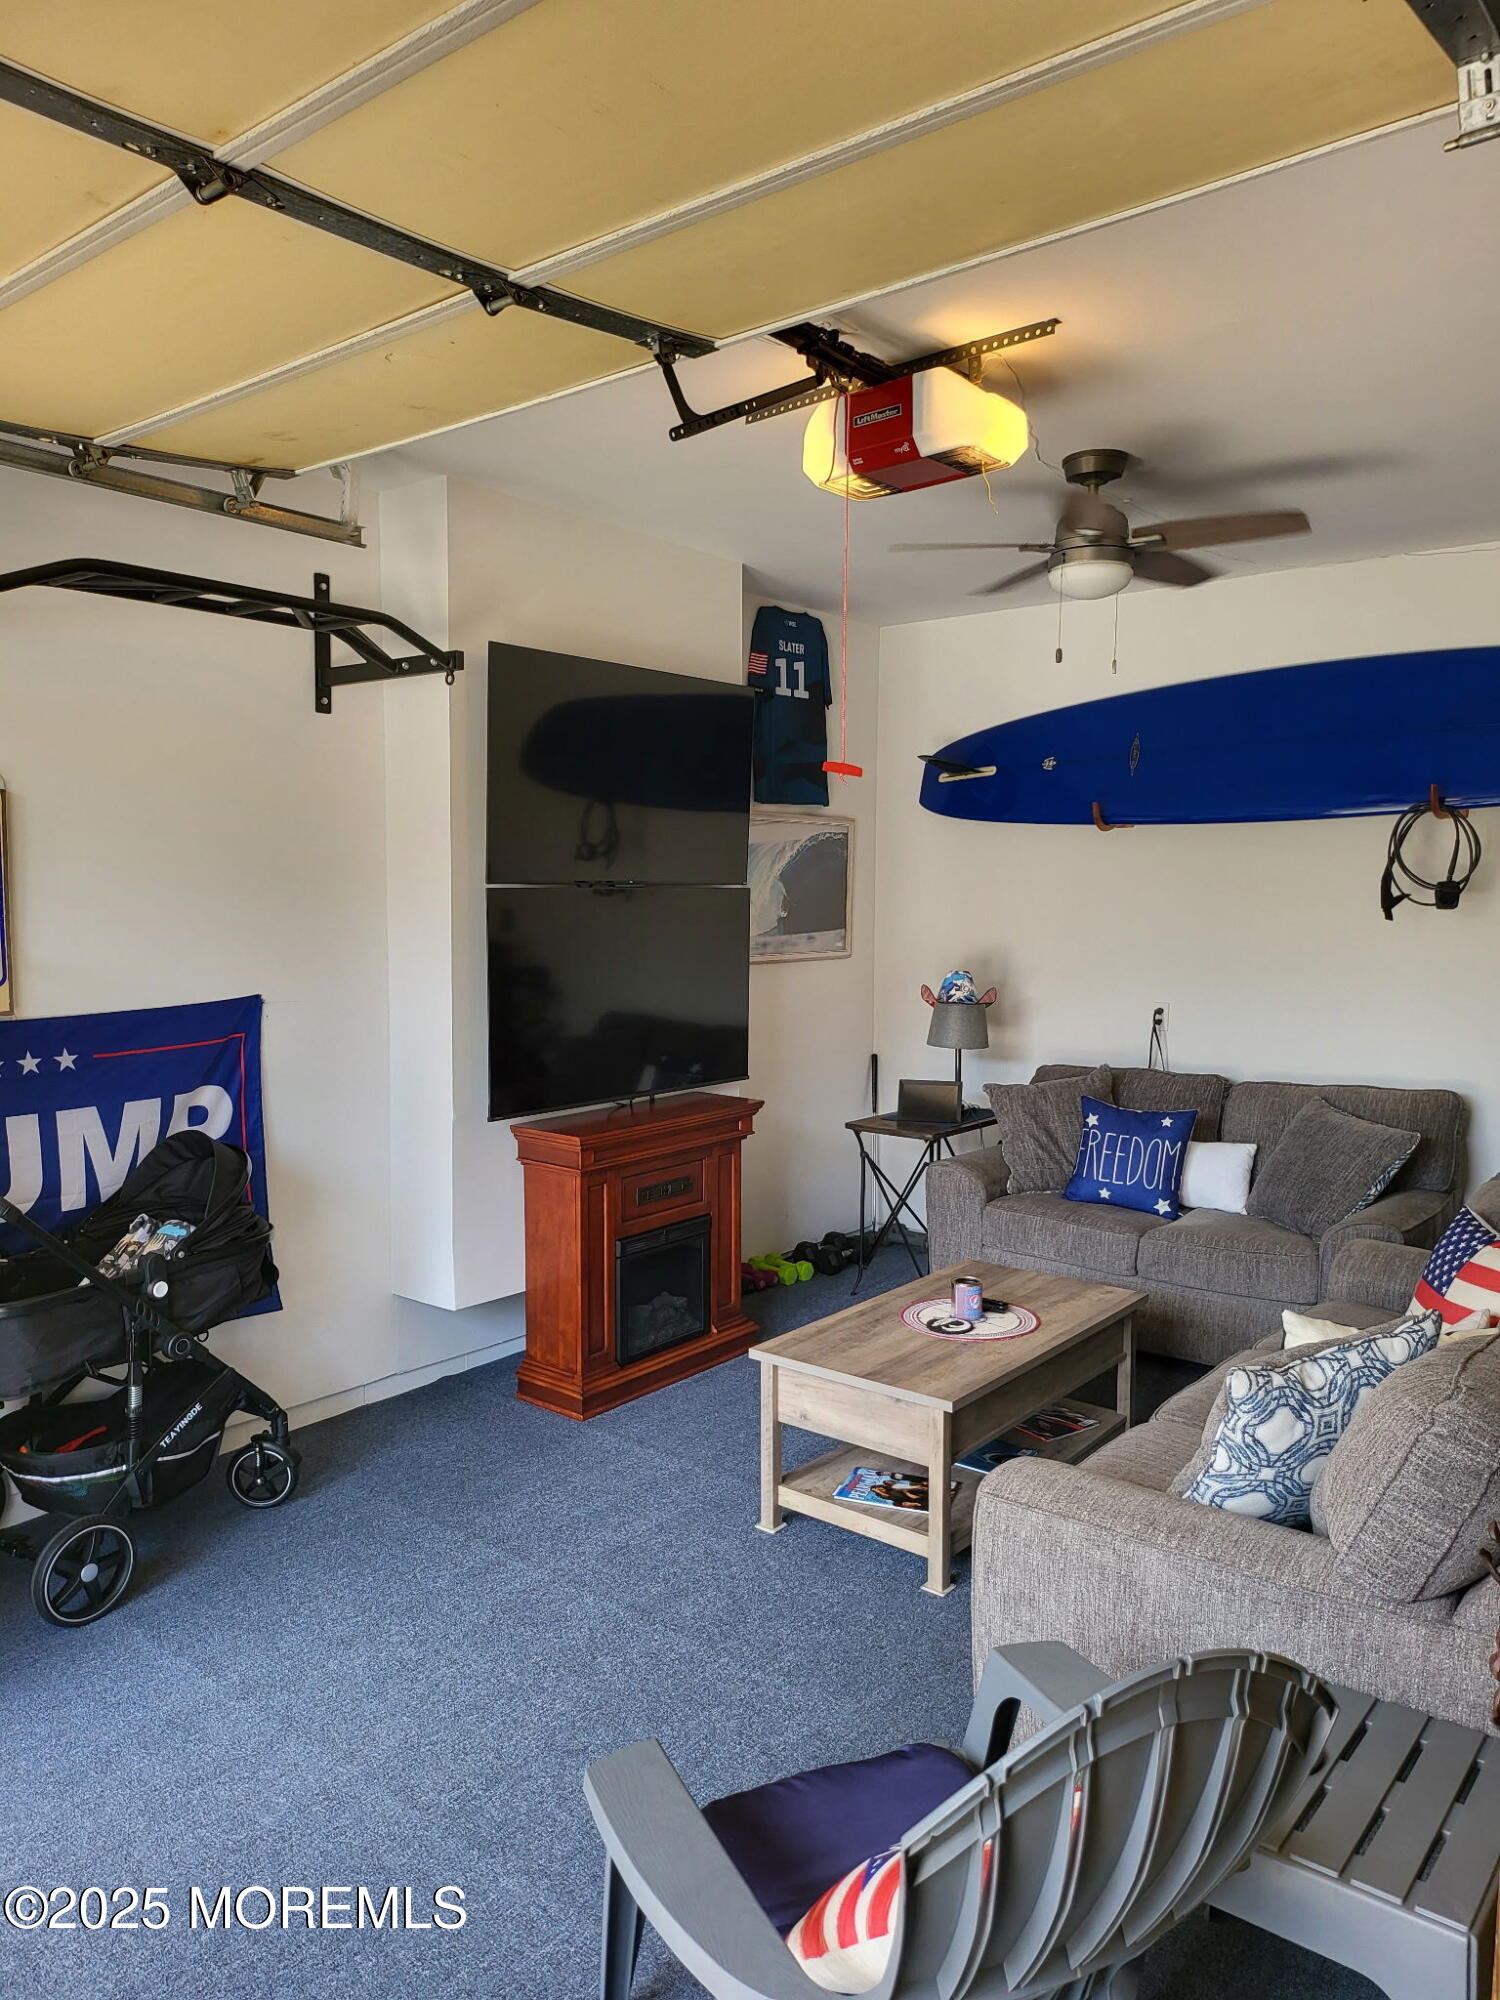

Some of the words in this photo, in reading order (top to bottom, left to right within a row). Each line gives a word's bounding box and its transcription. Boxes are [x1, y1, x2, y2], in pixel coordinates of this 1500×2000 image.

[778, 639, 805, 655] SLATER
[775, 658, 810, 700] 11
[1073, 1128, 1182, 1191] FREEDOM
[160, 1402, 203, 1448] TEAYINGDE
